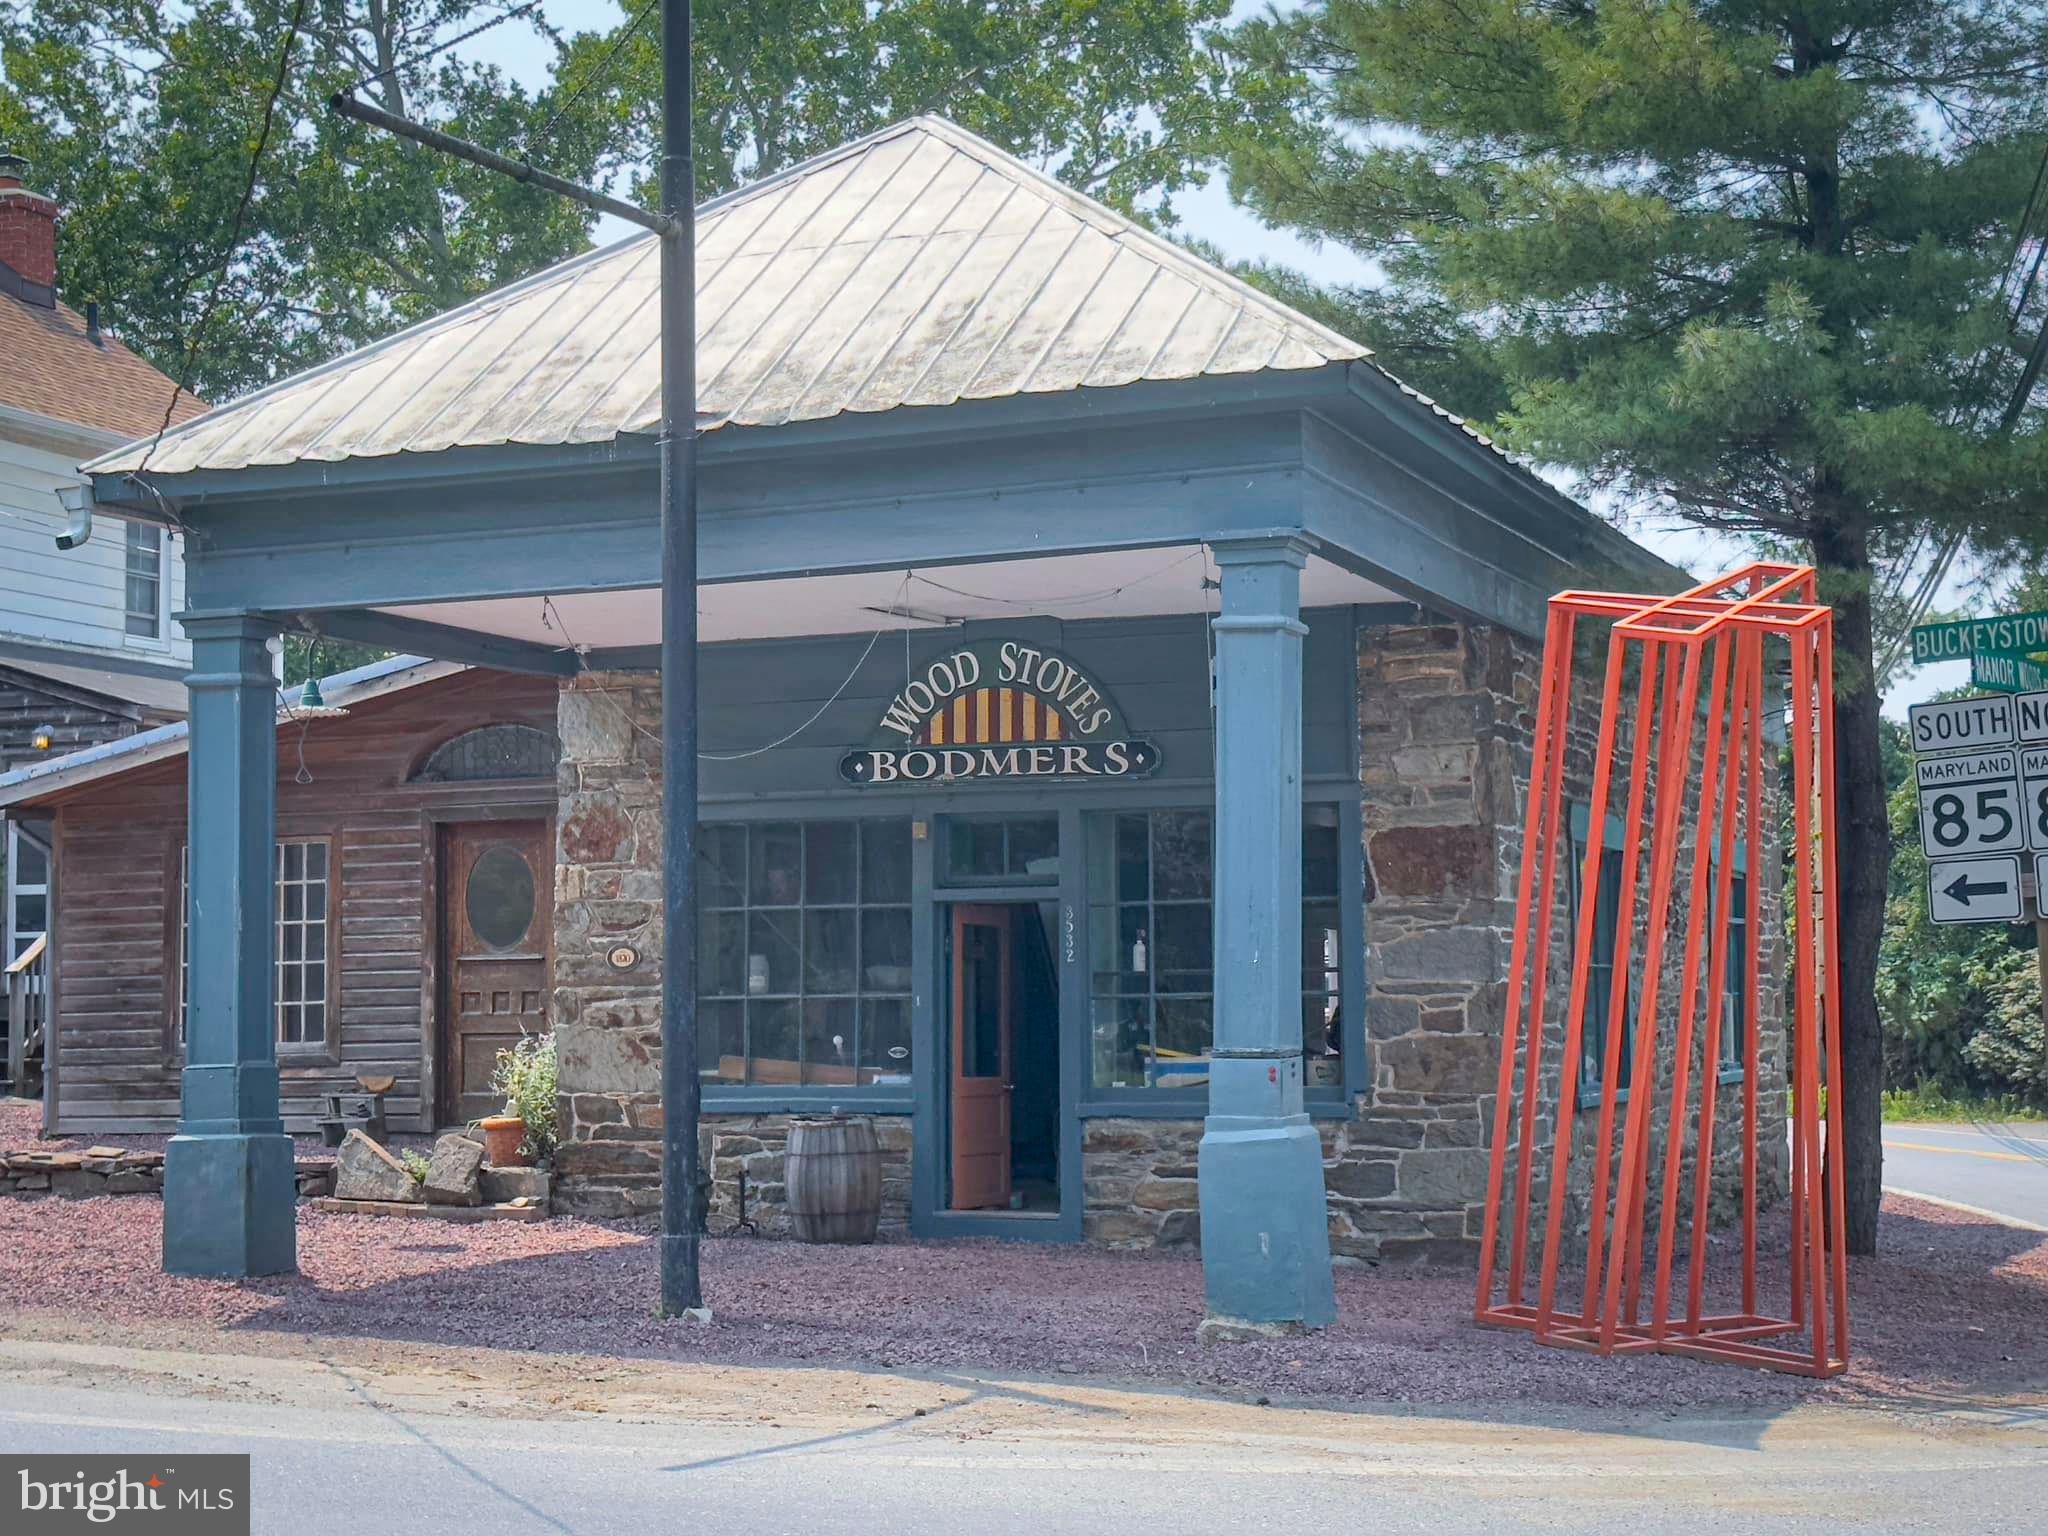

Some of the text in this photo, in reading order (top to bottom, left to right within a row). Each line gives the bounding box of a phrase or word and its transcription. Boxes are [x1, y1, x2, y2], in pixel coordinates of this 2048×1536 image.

[1975, 654, 2015, 686] MANOR
[880, 641, 1112, 736] WOOD STOVES
[1917, 706, 2008, 742] SOUTH
[2021, 700, 2048, 731] N
[1921, 756, 2012, 781] MARYLAND
[1932, 788, 2013, 848] 85
